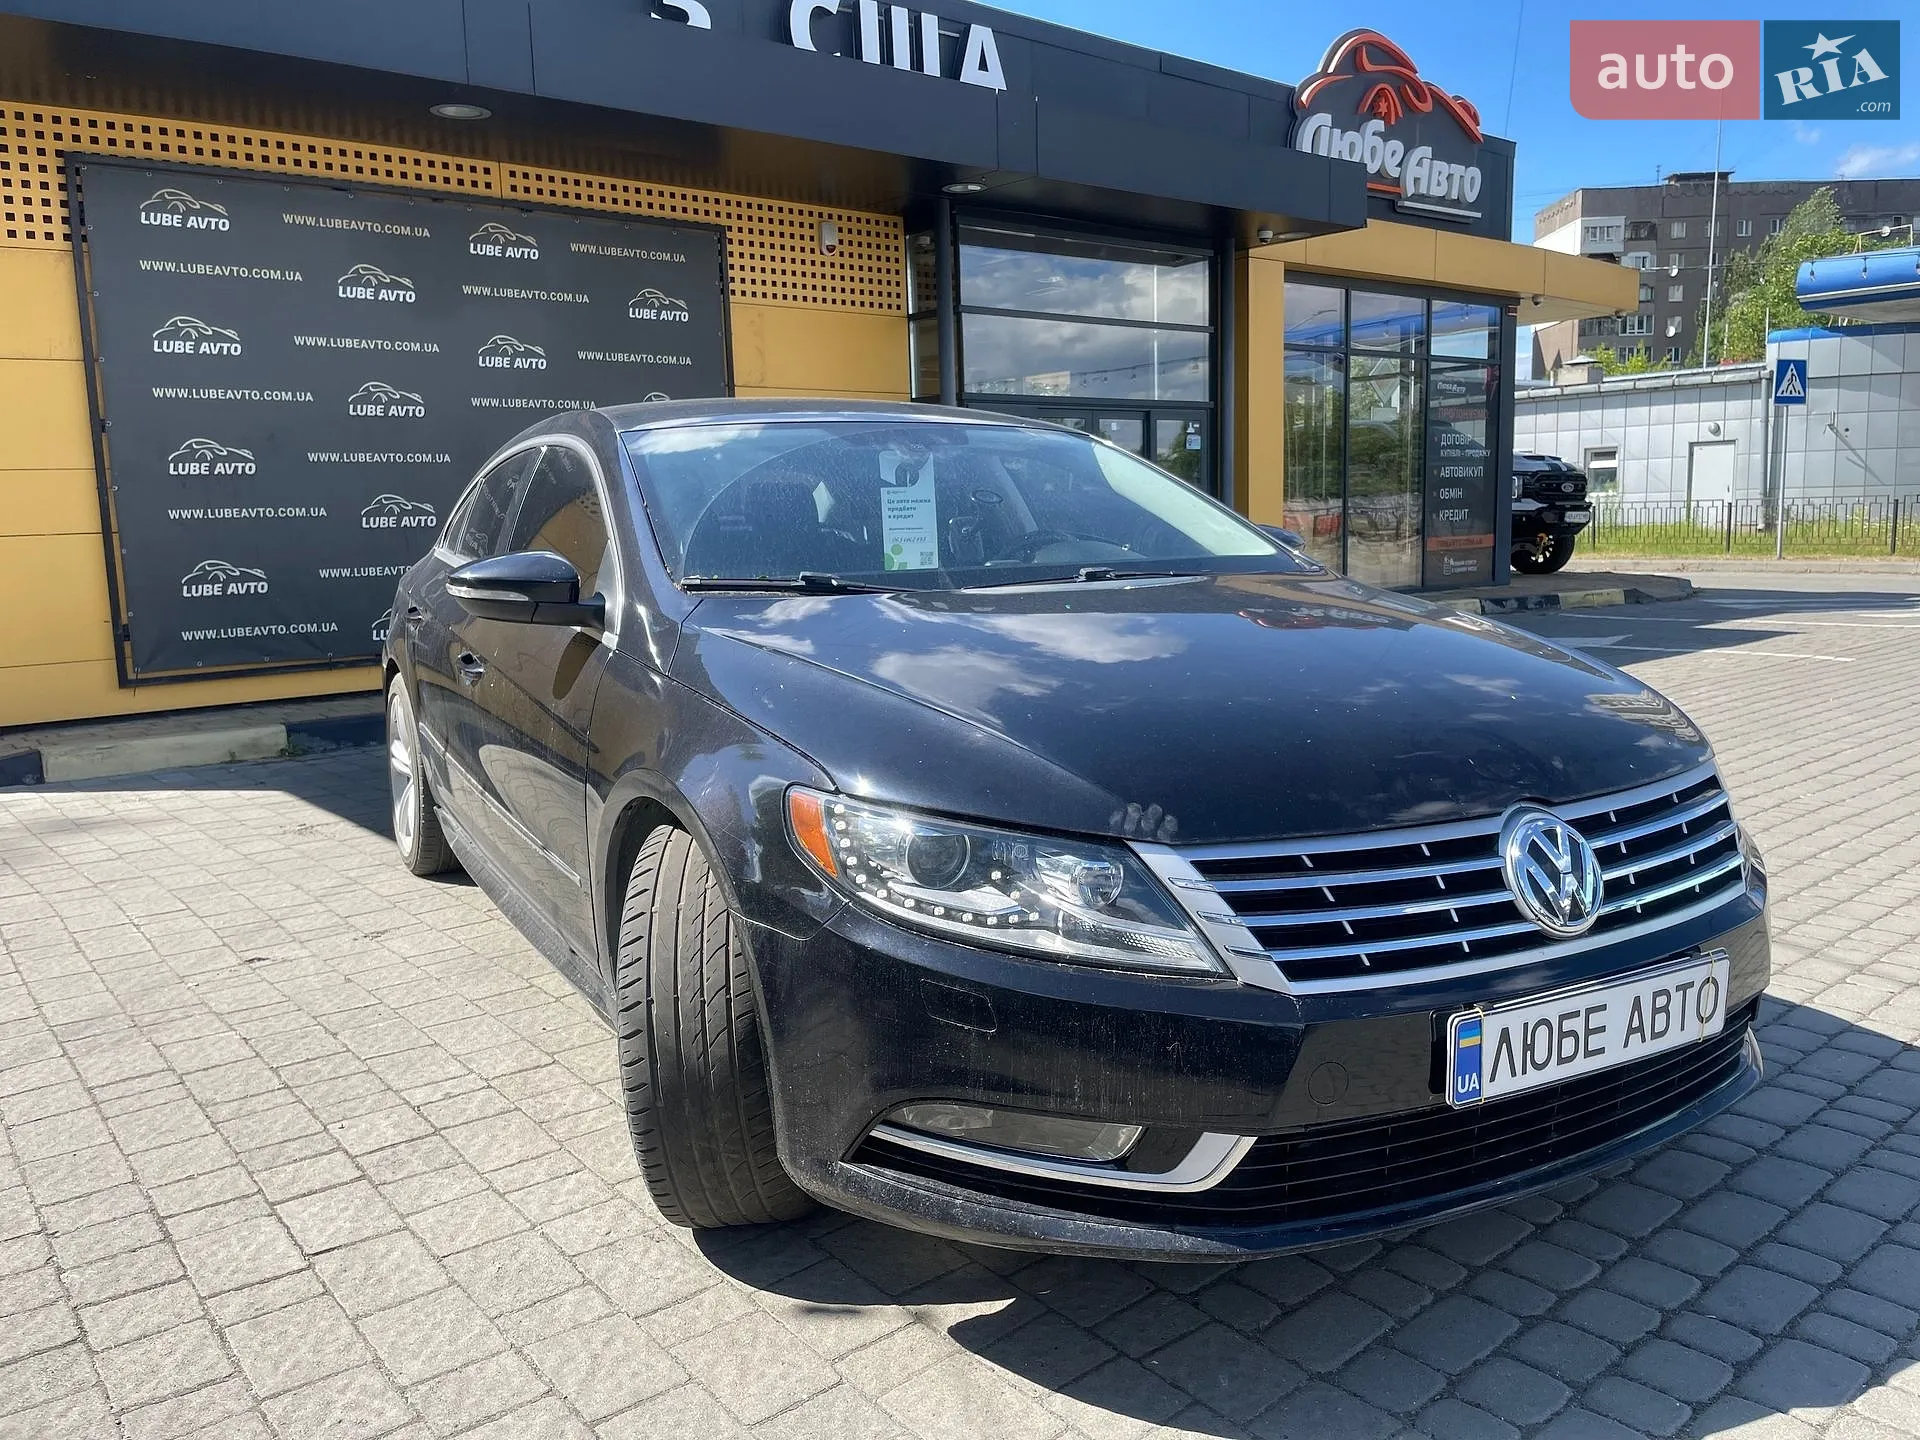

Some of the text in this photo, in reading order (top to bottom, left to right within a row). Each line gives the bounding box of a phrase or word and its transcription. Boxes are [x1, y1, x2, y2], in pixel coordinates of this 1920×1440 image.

[140, 211, 230, 231] LUBE AVTO
[282, 213, 430, 238] WWW.LUBEAVTO.COM.UA
[469, 242, 539, 260] LUBE AVTO
[570, 242, 686, 263] WWW.LUBEAVTO.COM.UA
[140, 260, 303, 282] WWW.LUBEAVTO.COM.UA
[338, 285, 416, 303] LUBE AVTO
[462, 285, 590, 304] WWW.LUBEAVTO.COM.UA
[629, 308, 689, 322] LUBE AVTO
[153, 340, 242, 356] LUBE AVTO
[294, 335, 440, 354] WWW.LUBEAVTO.COM.UA
[478, 356, 547, 370] LUBE AVTO
[577, 351, 692, 366] WWW.LUBEAVTO.COM.UA
[152, 387, 314, 403] WWW.LUBEAVTO.COM.UA
[349, 403, 425, 418] LUBE AVTO
[471, 397, 597, 411] WWW.LUBEAVTO.COM.UA
[1440, 433, 1472, 447] ДОГОВІР
[307, 452, 451, 463] WWW.LUBEAVTO.COM.UA
[169, 462, 256, 475] LUBE AVTO
[1440, 465, 1484, 478] АВТОВИКУП
[1439, 487, 1463, 499] ОБМІН
[168, 506, 327, 520] WWW.LUBEAVTO.COM.UA
[1439, 508, 1469, 522] КРЕДИТ
[362, 515, 437, 529] LUBE AVTO
[182, 581, 268, 597] LUBE AVTO
[181, 622, 338, 641] WWW.LUBEAVTO.COM.UA
[1489, 976, 1720, 1083] ЛЮБЕ АВТО
[1457, 1072, 1479, 1093] UA
